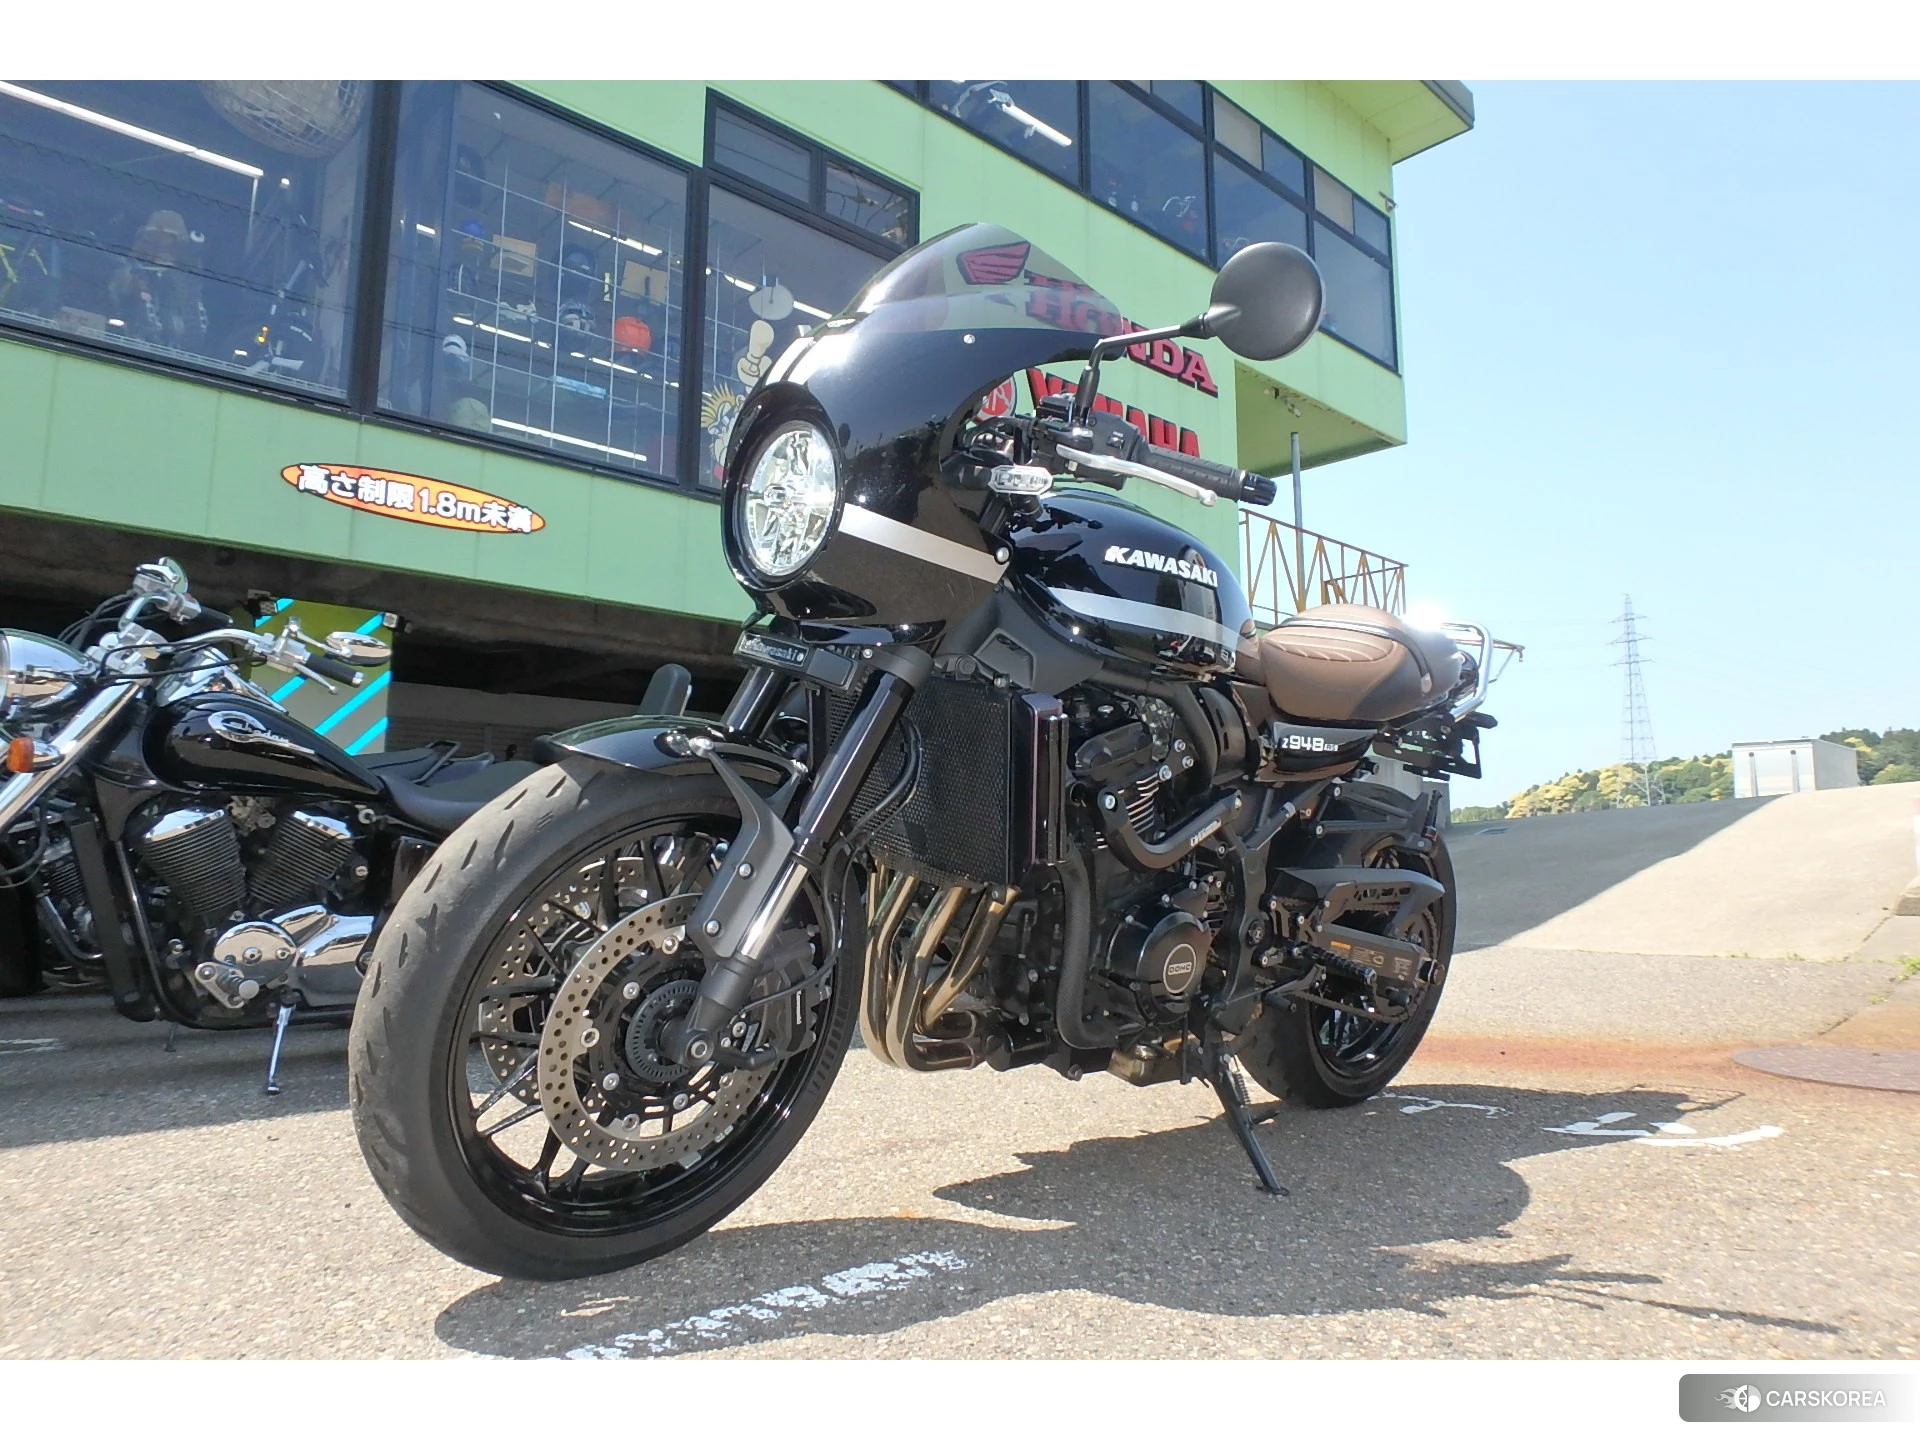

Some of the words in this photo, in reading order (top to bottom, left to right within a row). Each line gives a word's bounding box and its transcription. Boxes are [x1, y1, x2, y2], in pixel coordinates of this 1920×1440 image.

[299, 464, 533, 533] 高さ制限1.8m未満
[1104, 545, 1218, 588] KAWASAKI
